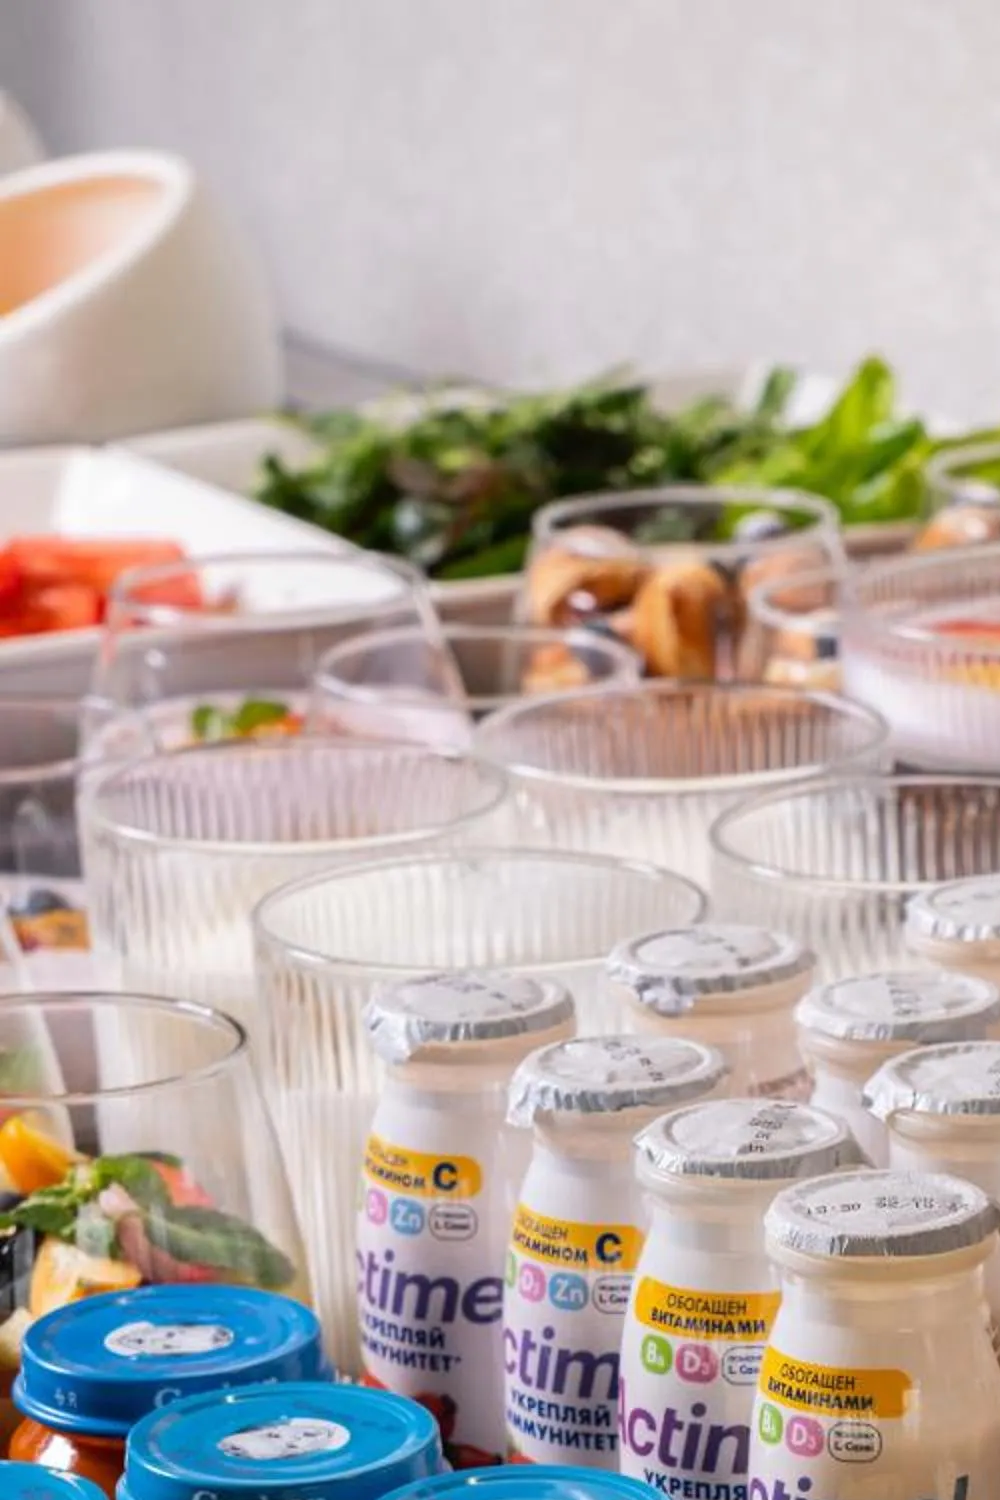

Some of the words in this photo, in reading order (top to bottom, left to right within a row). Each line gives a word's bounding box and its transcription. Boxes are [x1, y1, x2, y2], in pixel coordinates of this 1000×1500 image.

[667, 1293, 748, 1316] ОБОГАЩЕН
[651, 1306, 766, 1334] ВИТАМИНАМИ
[779, 1363, 856, 1391] ОБОГАЩЕН
[767, 1376, 874, 1411] ВИТАМИНАМИ
